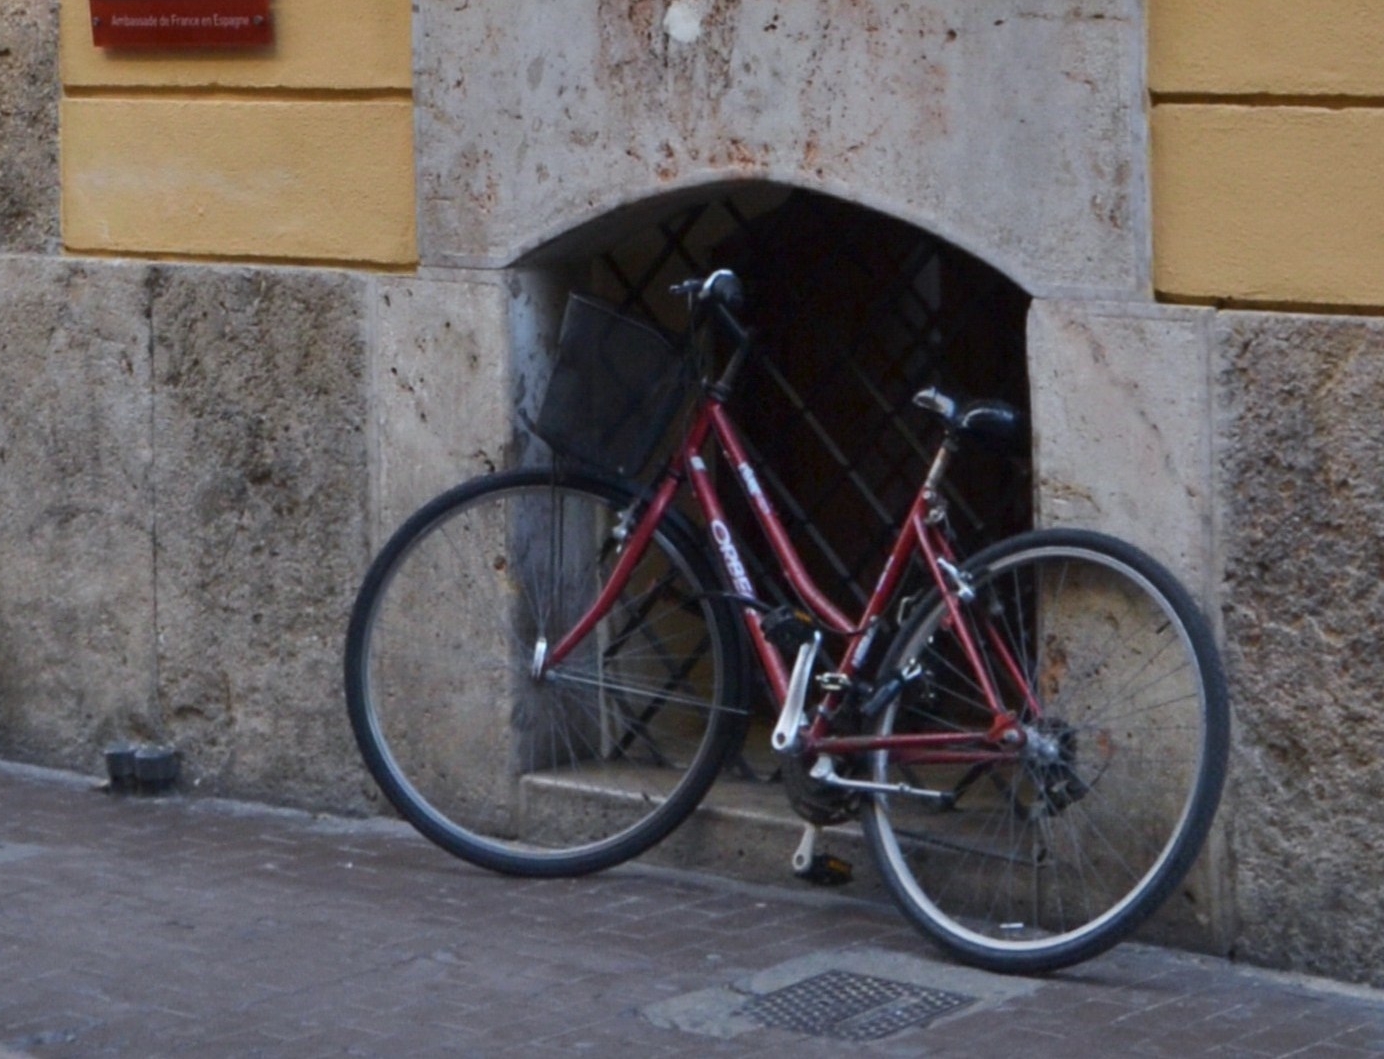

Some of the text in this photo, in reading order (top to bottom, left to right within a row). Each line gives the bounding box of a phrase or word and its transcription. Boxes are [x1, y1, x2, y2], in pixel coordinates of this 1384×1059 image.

[111, 14, 158, 27] Ambassade
[171, 14, 199, 27] France
[201, 16, 212, 27] en
[213, 14, 250, 29] Espagne
